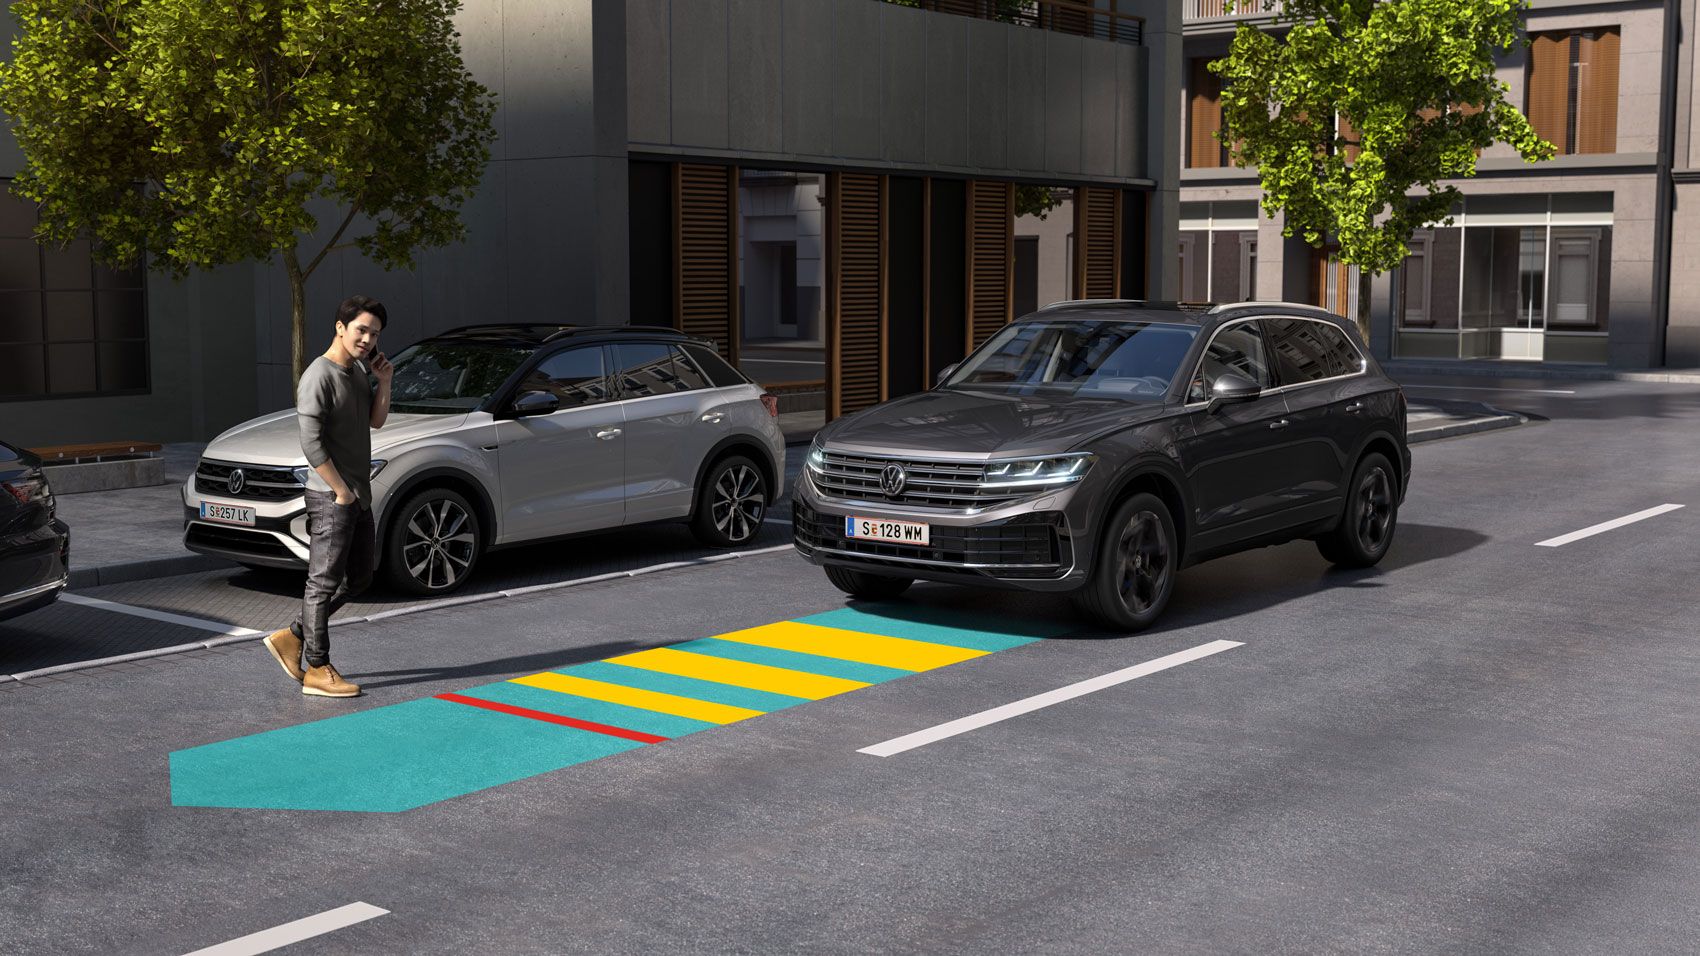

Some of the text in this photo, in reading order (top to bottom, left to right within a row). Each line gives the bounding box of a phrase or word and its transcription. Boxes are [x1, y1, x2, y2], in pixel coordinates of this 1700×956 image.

[210, 506, 249, 522] S 257 LK
[862, 521, 870, 536] S
[879, 523, 901, 539] 128
[904, 525, 922, 541] WM
